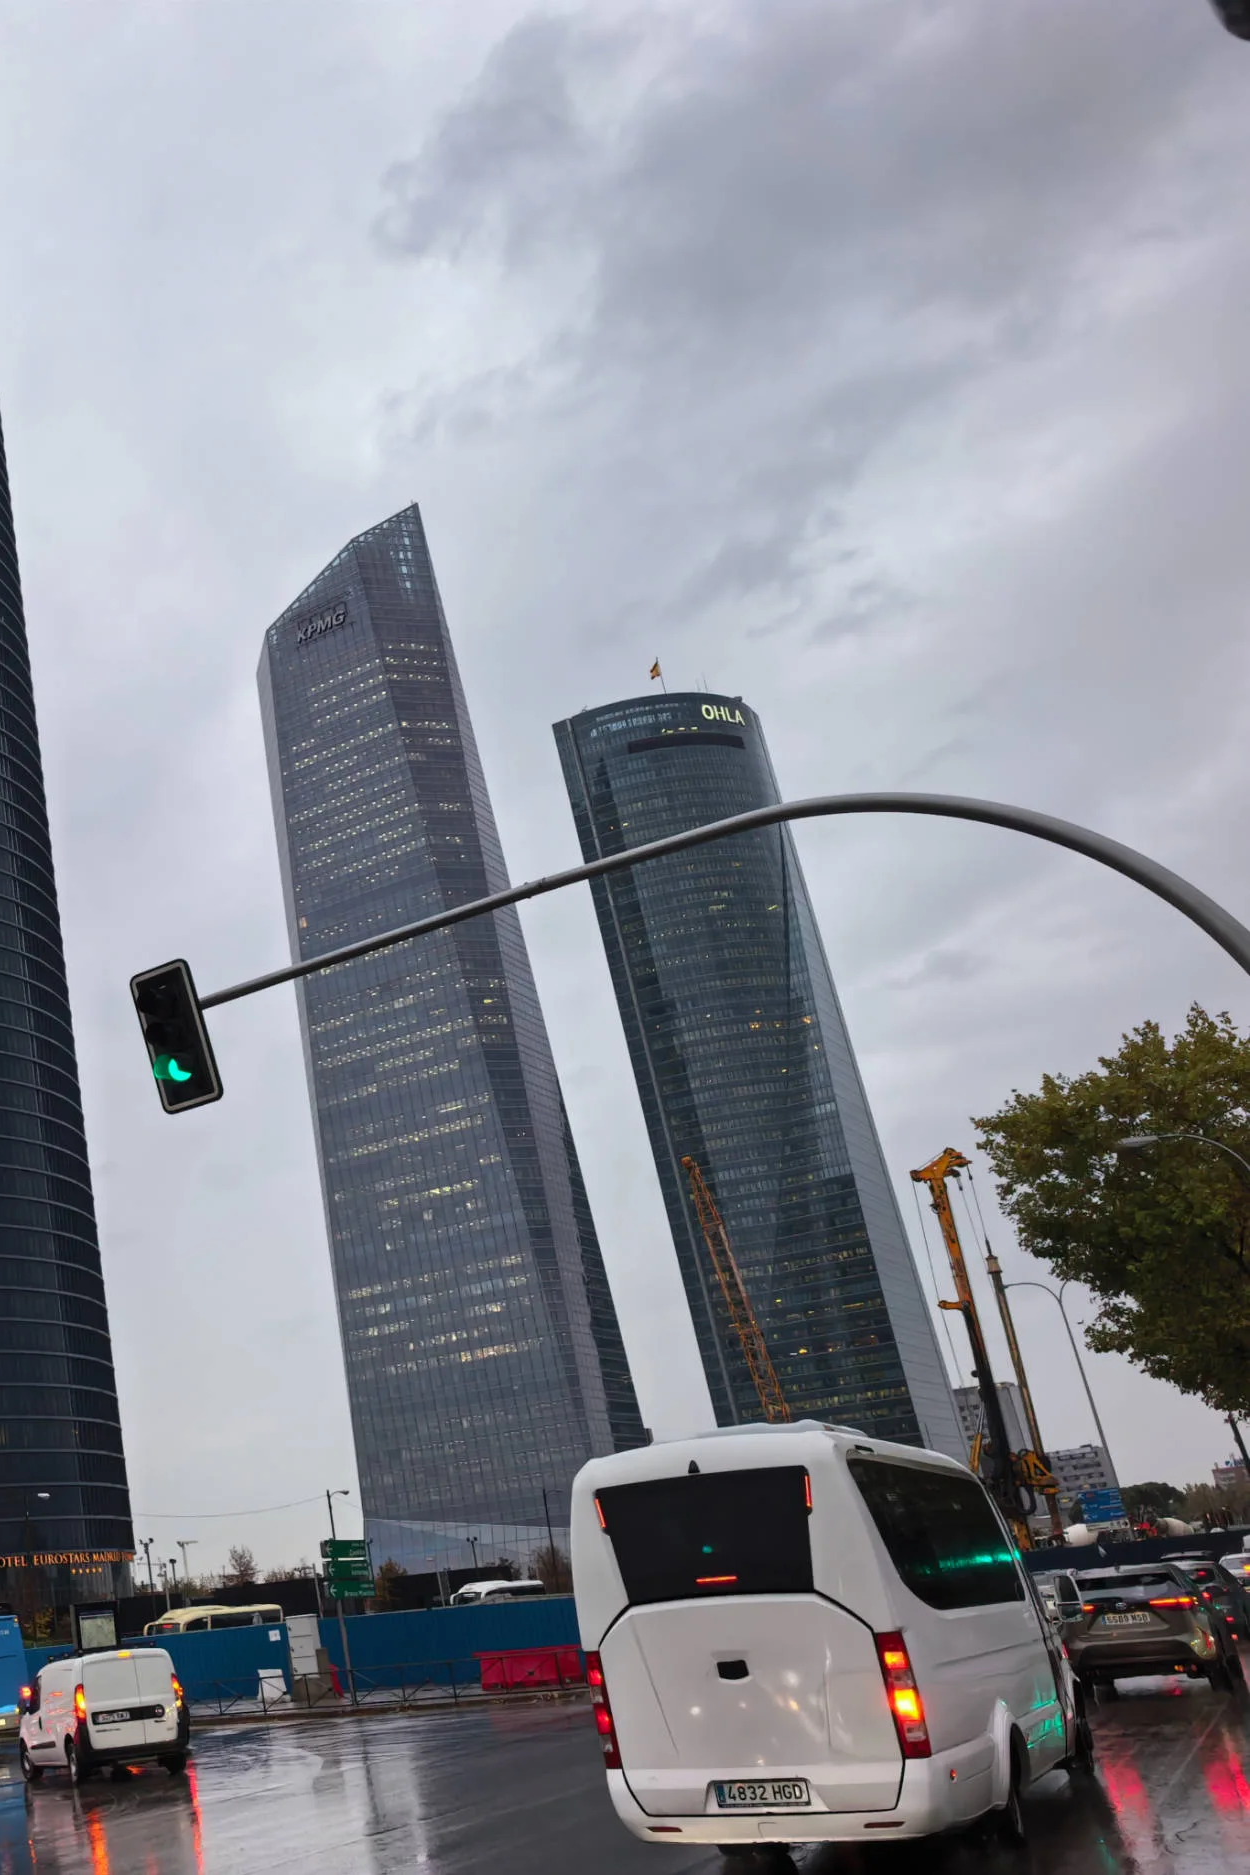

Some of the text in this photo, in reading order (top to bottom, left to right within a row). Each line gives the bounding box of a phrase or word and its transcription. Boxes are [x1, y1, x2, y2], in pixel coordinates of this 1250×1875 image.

[296, 608, 348, 643] KPMG
[701, 704, 746, 727] OHLA
[33, 1553, 91, 1565] EUROSTARS
[728, 1784, 803, 1801] 4832 HGD
